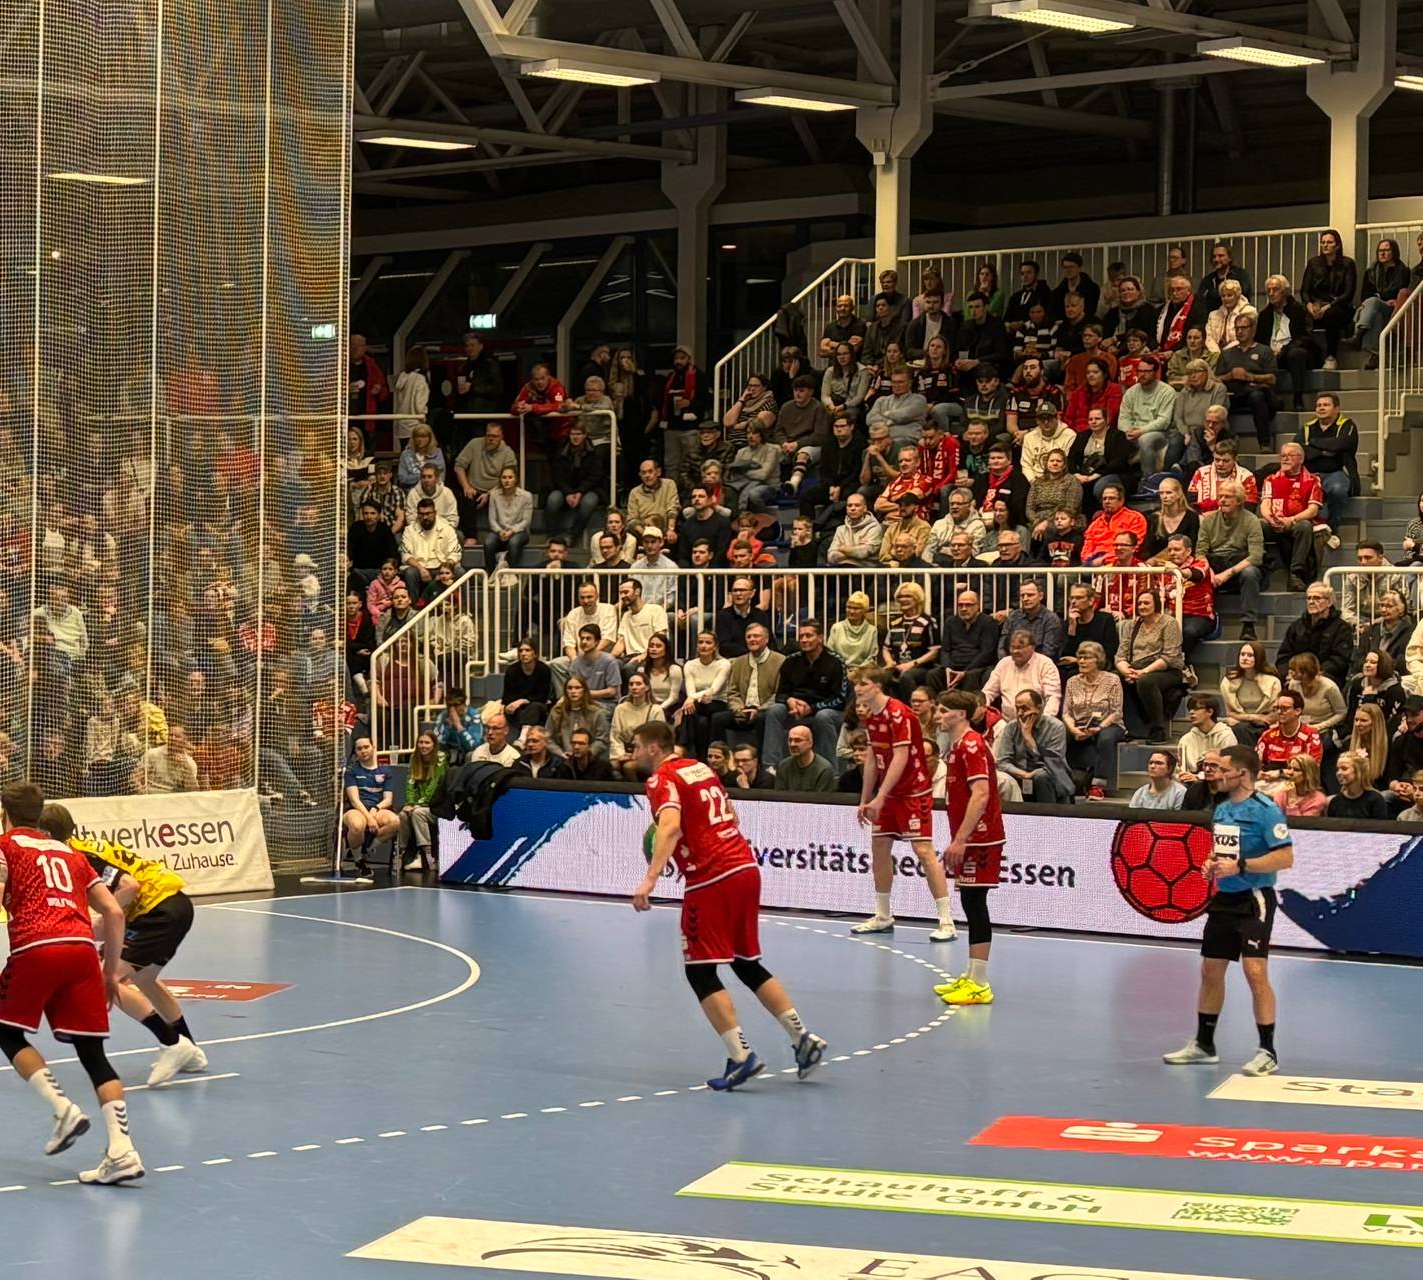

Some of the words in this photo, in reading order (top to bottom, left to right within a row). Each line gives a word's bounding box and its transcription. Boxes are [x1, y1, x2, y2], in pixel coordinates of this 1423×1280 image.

[699, 785, 735, 826] 22
[35, 853, 74, 893] 10
[172, 852, 238, 871] Zuhause.
[998, 854, 1076, 888] Essen
[1282, 1080, 1423, 1098] Sta
[936, 1193, 1103, 1214] GmbH
